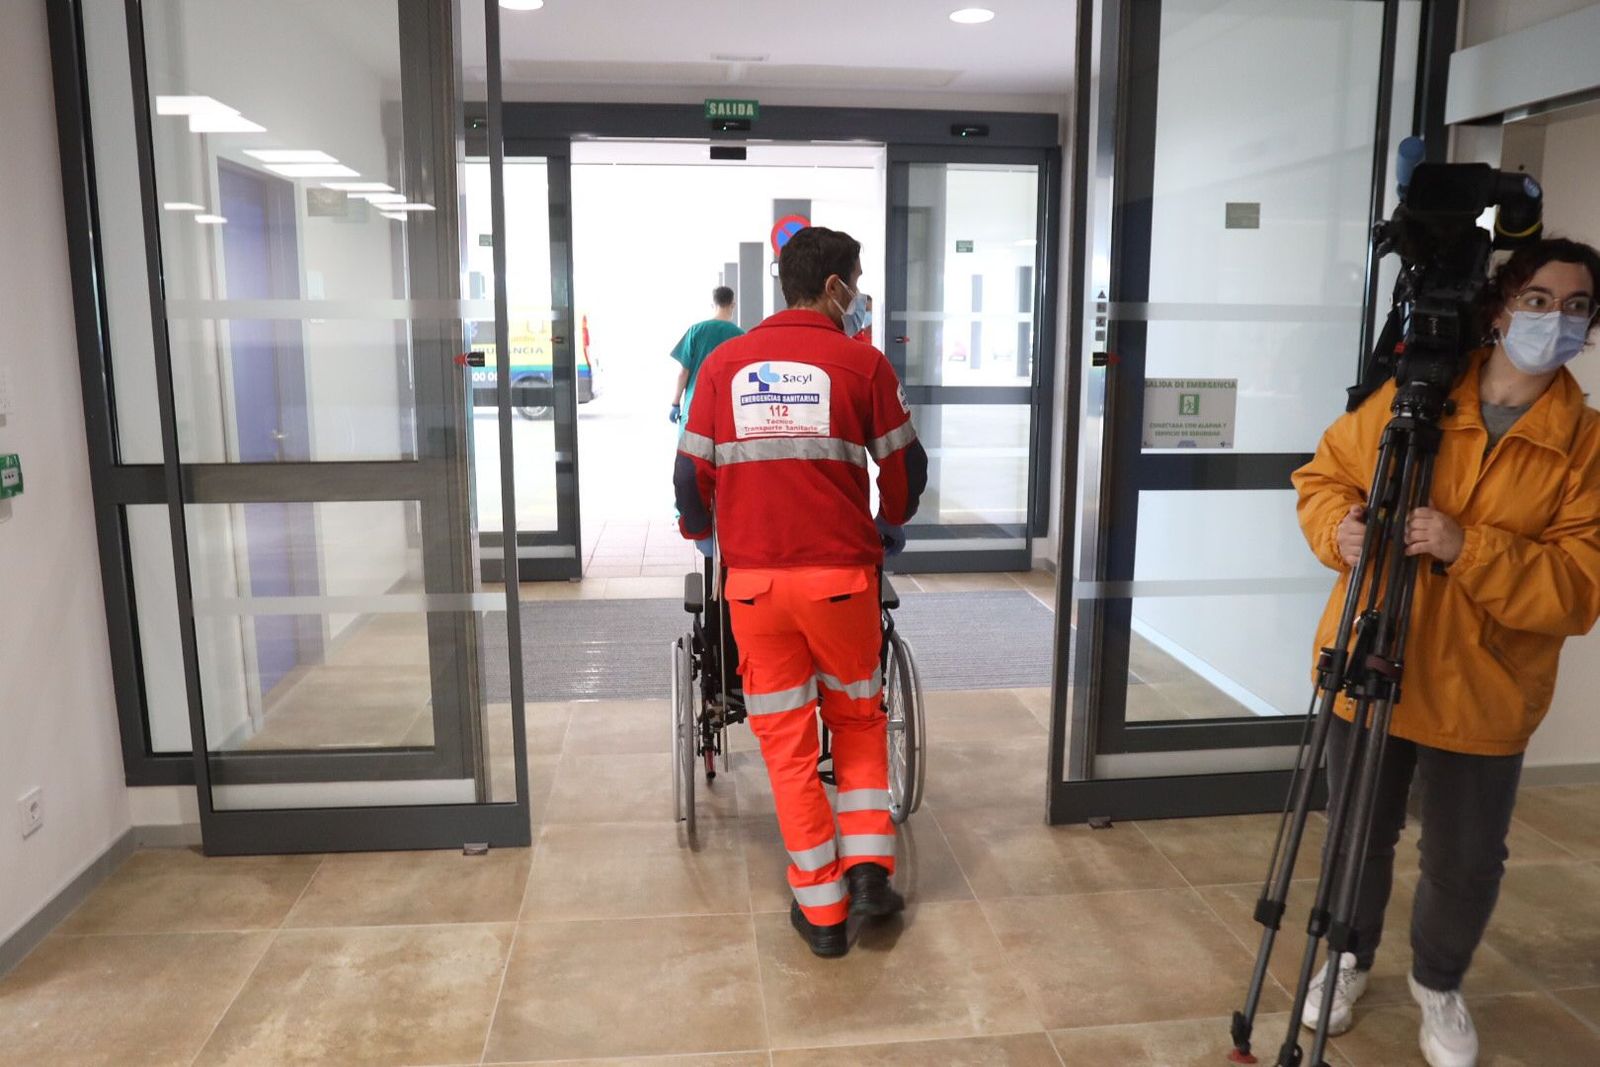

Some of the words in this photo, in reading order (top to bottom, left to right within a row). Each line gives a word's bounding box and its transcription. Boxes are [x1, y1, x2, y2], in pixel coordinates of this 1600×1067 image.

[710, 102, 754, 116] SALIDA
[782, 374, 812, 384] Sacyl
[741, 395, 780, 404] EMERGENCIAS
[769, 405, 788, 417] 112
